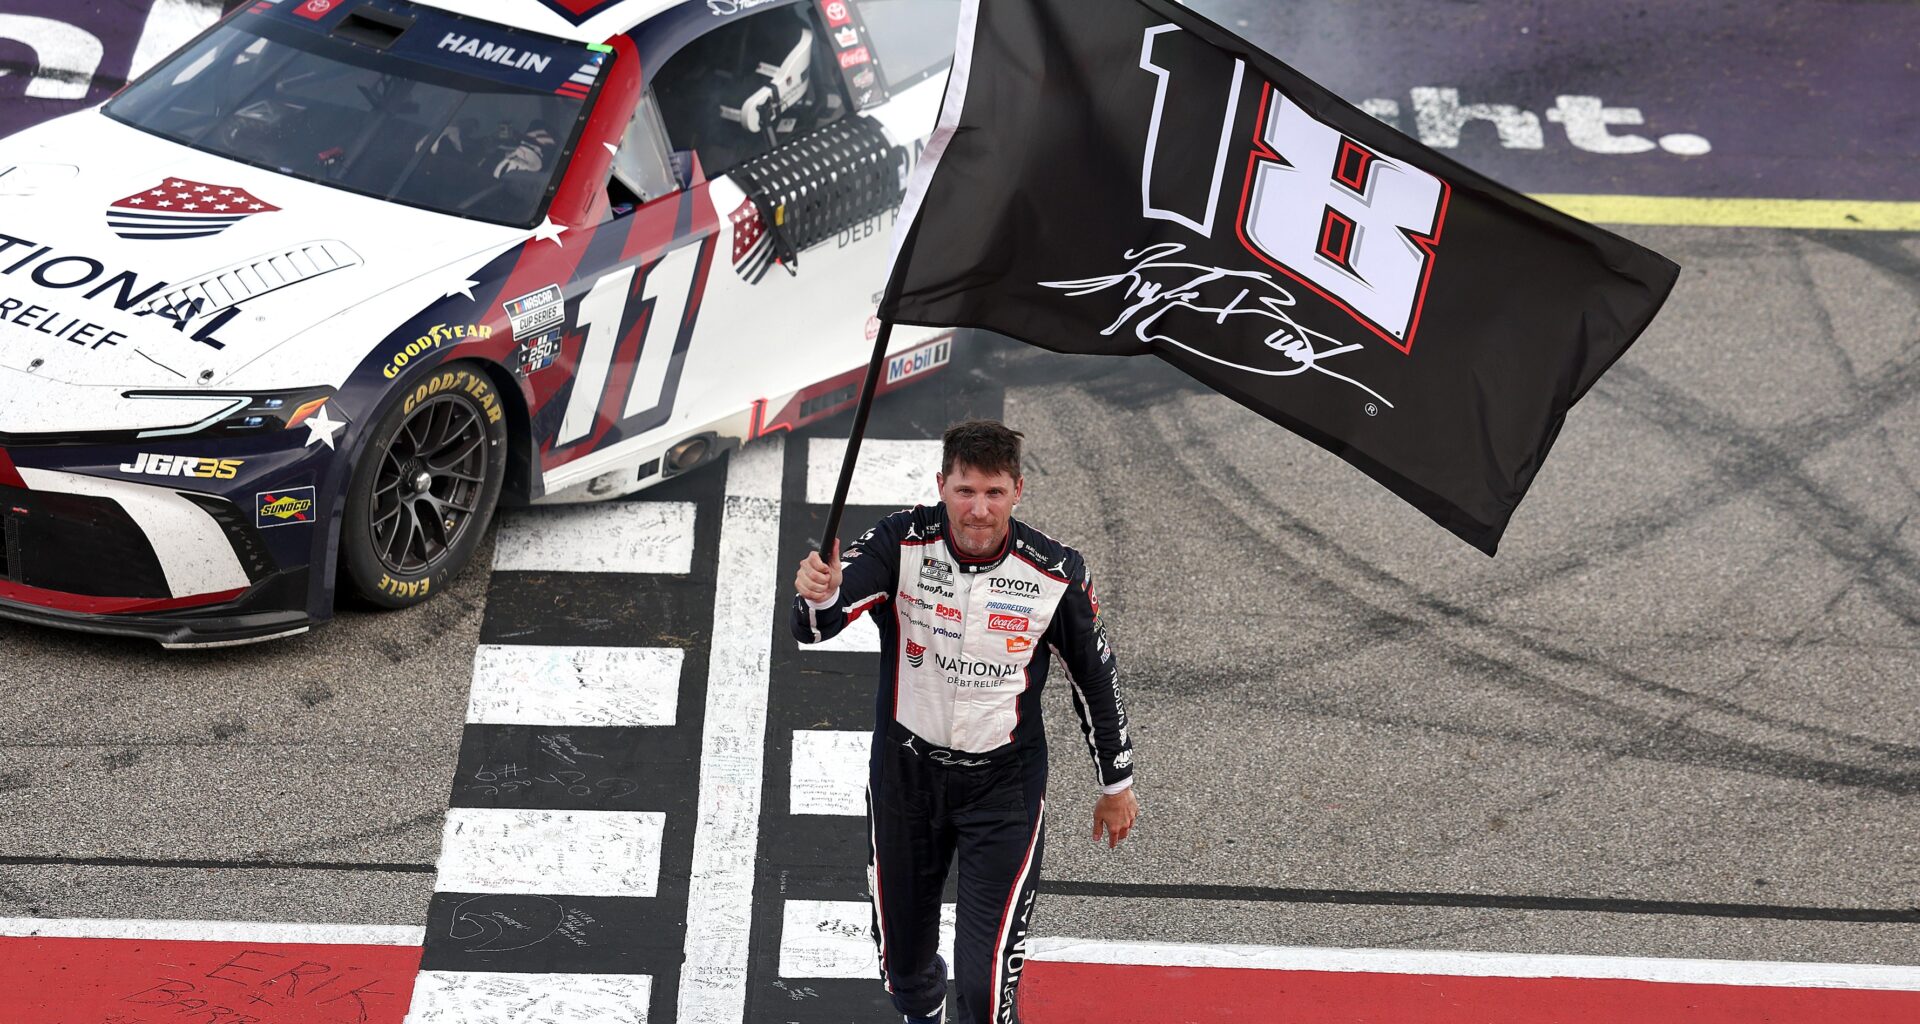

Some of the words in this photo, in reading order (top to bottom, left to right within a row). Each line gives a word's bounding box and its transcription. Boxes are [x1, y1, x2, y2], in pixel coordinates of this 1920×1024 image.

[437, 32, 552, 74] HAMLIN
[1356, 87, 1712, 155] ht.
[1139, 23, 1451, 355] 18
[524, 290, 553, 311] NASCAR
[0, 297, 128, 350] RELIEF
[520, 316, 533, 329] CUP
[534, 306, 557, 324] SERIES
[383, 324, 493, 379] GOODYEAR
[528, 342, 553, 362] 250
[555, 239, 704, 448] 11
[889, 348, 931, 380] Mobil
[934, 342, 949, 364] 1
[403, 370, 502, 424] GOODYEAR
[262, 501, 310, 516] SUNOCO
[378, 573, 430, 598] EAGLE
[917, 582, 954, 598] OODYAR
[987, 588, 1040, 599] RACING
[988, 578, 1040, 594] TOYOTA
[936, 603, 962, 619] BOB'S
[985, 601, 1034, 614] PROGRESSIVE
[933, 626, 962, 639] yahoo!
[990, 616, 1028, 631] Coca-Cola
[935, 653, 1020, 678] NATIONAL
[947, 677, 971, 688] DEBT
[973, 680, 1005, 688] RELIEF
[1110, 667, 1125, 726] NATIONL
[205, 950, 395, 1022] ERIK
